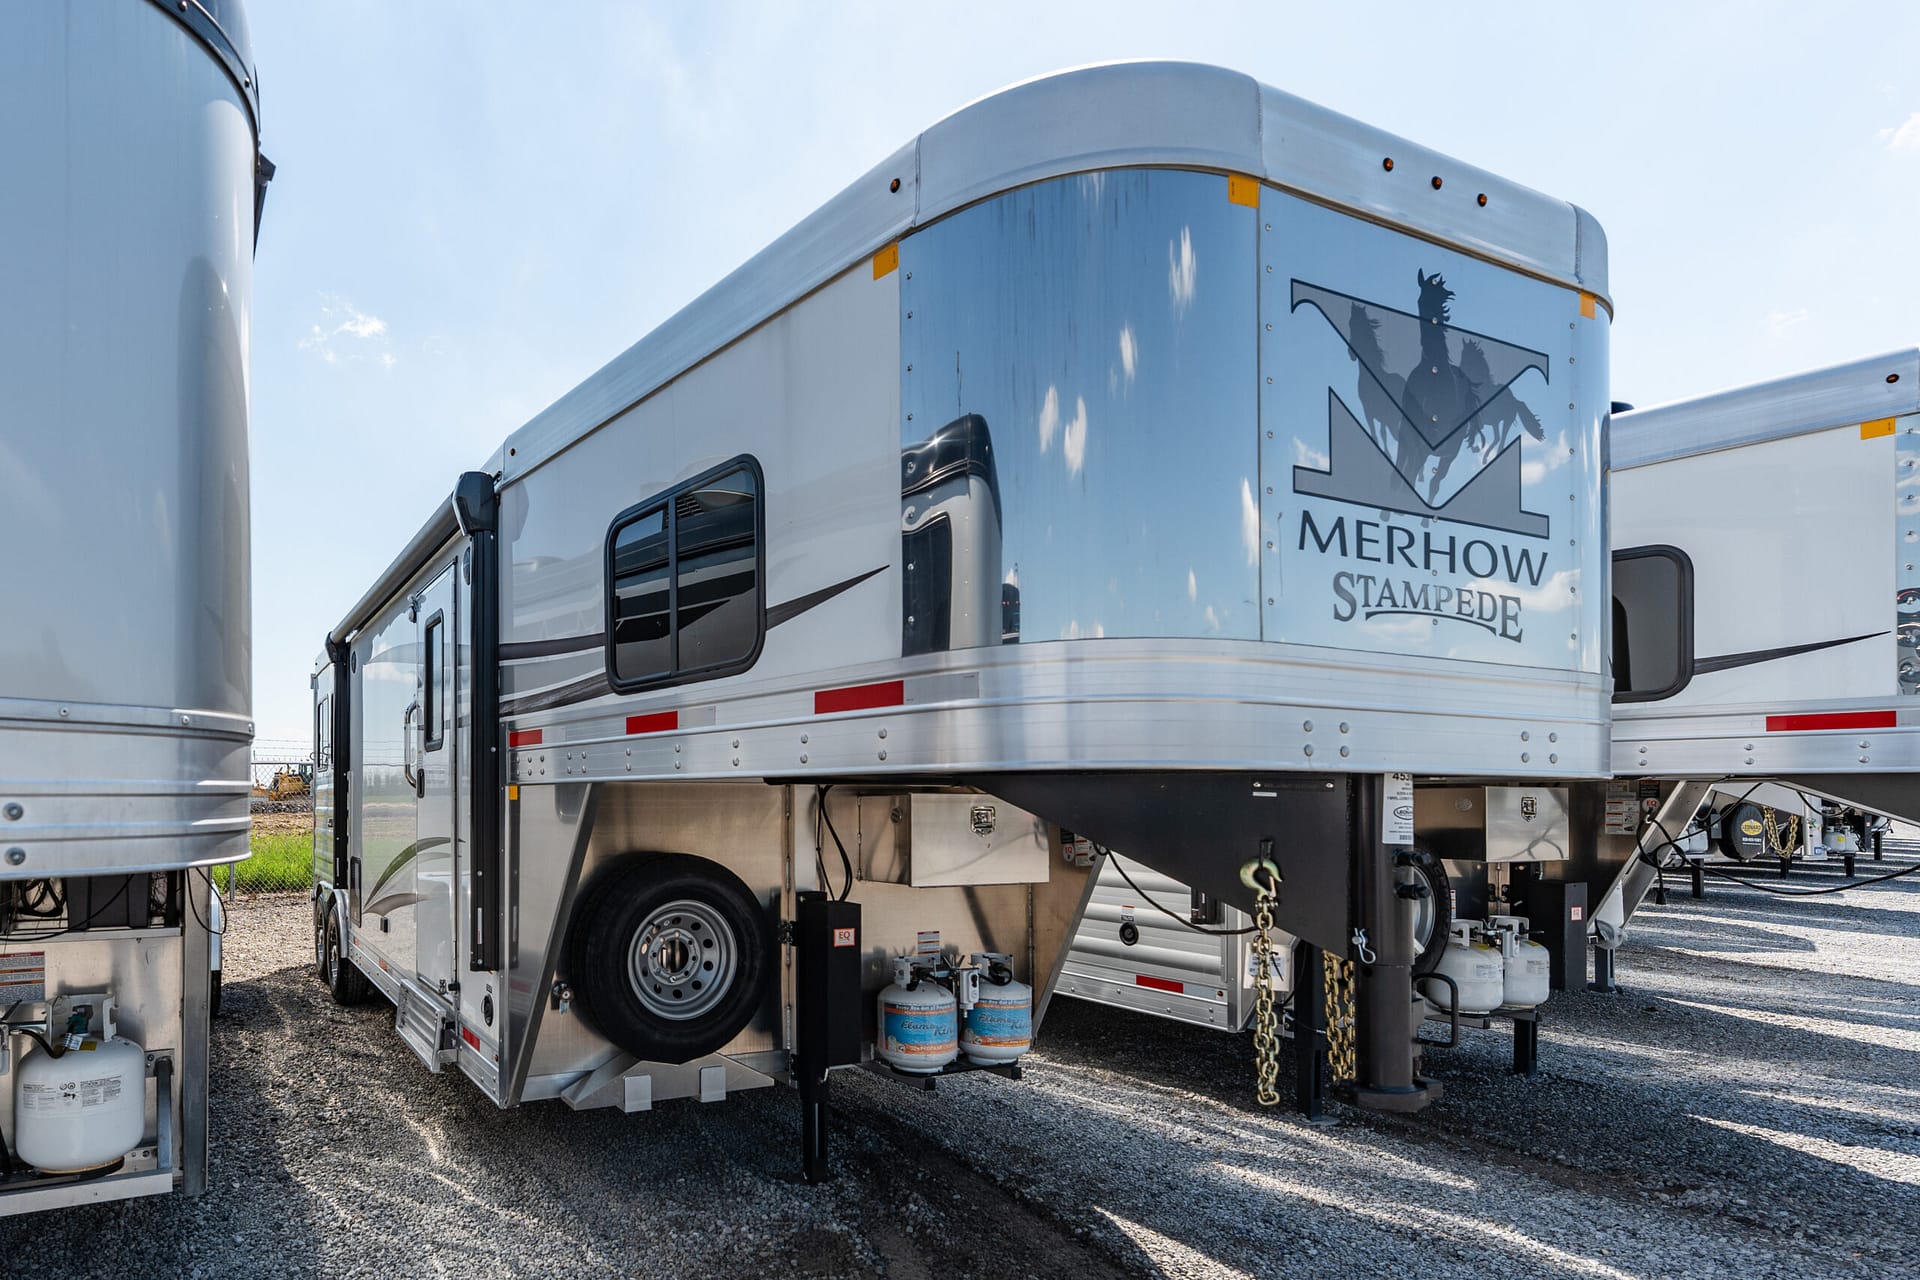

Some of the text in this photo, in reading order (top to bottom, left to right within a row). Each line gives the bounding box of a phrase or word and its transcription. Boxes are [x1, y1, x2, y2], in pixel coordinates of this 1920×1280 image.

[1298, 509, 1548, 586] MERHOW
[1333, 571, 1523, 643] STAMPEDE
[838, 930, 851, 941] EQ
